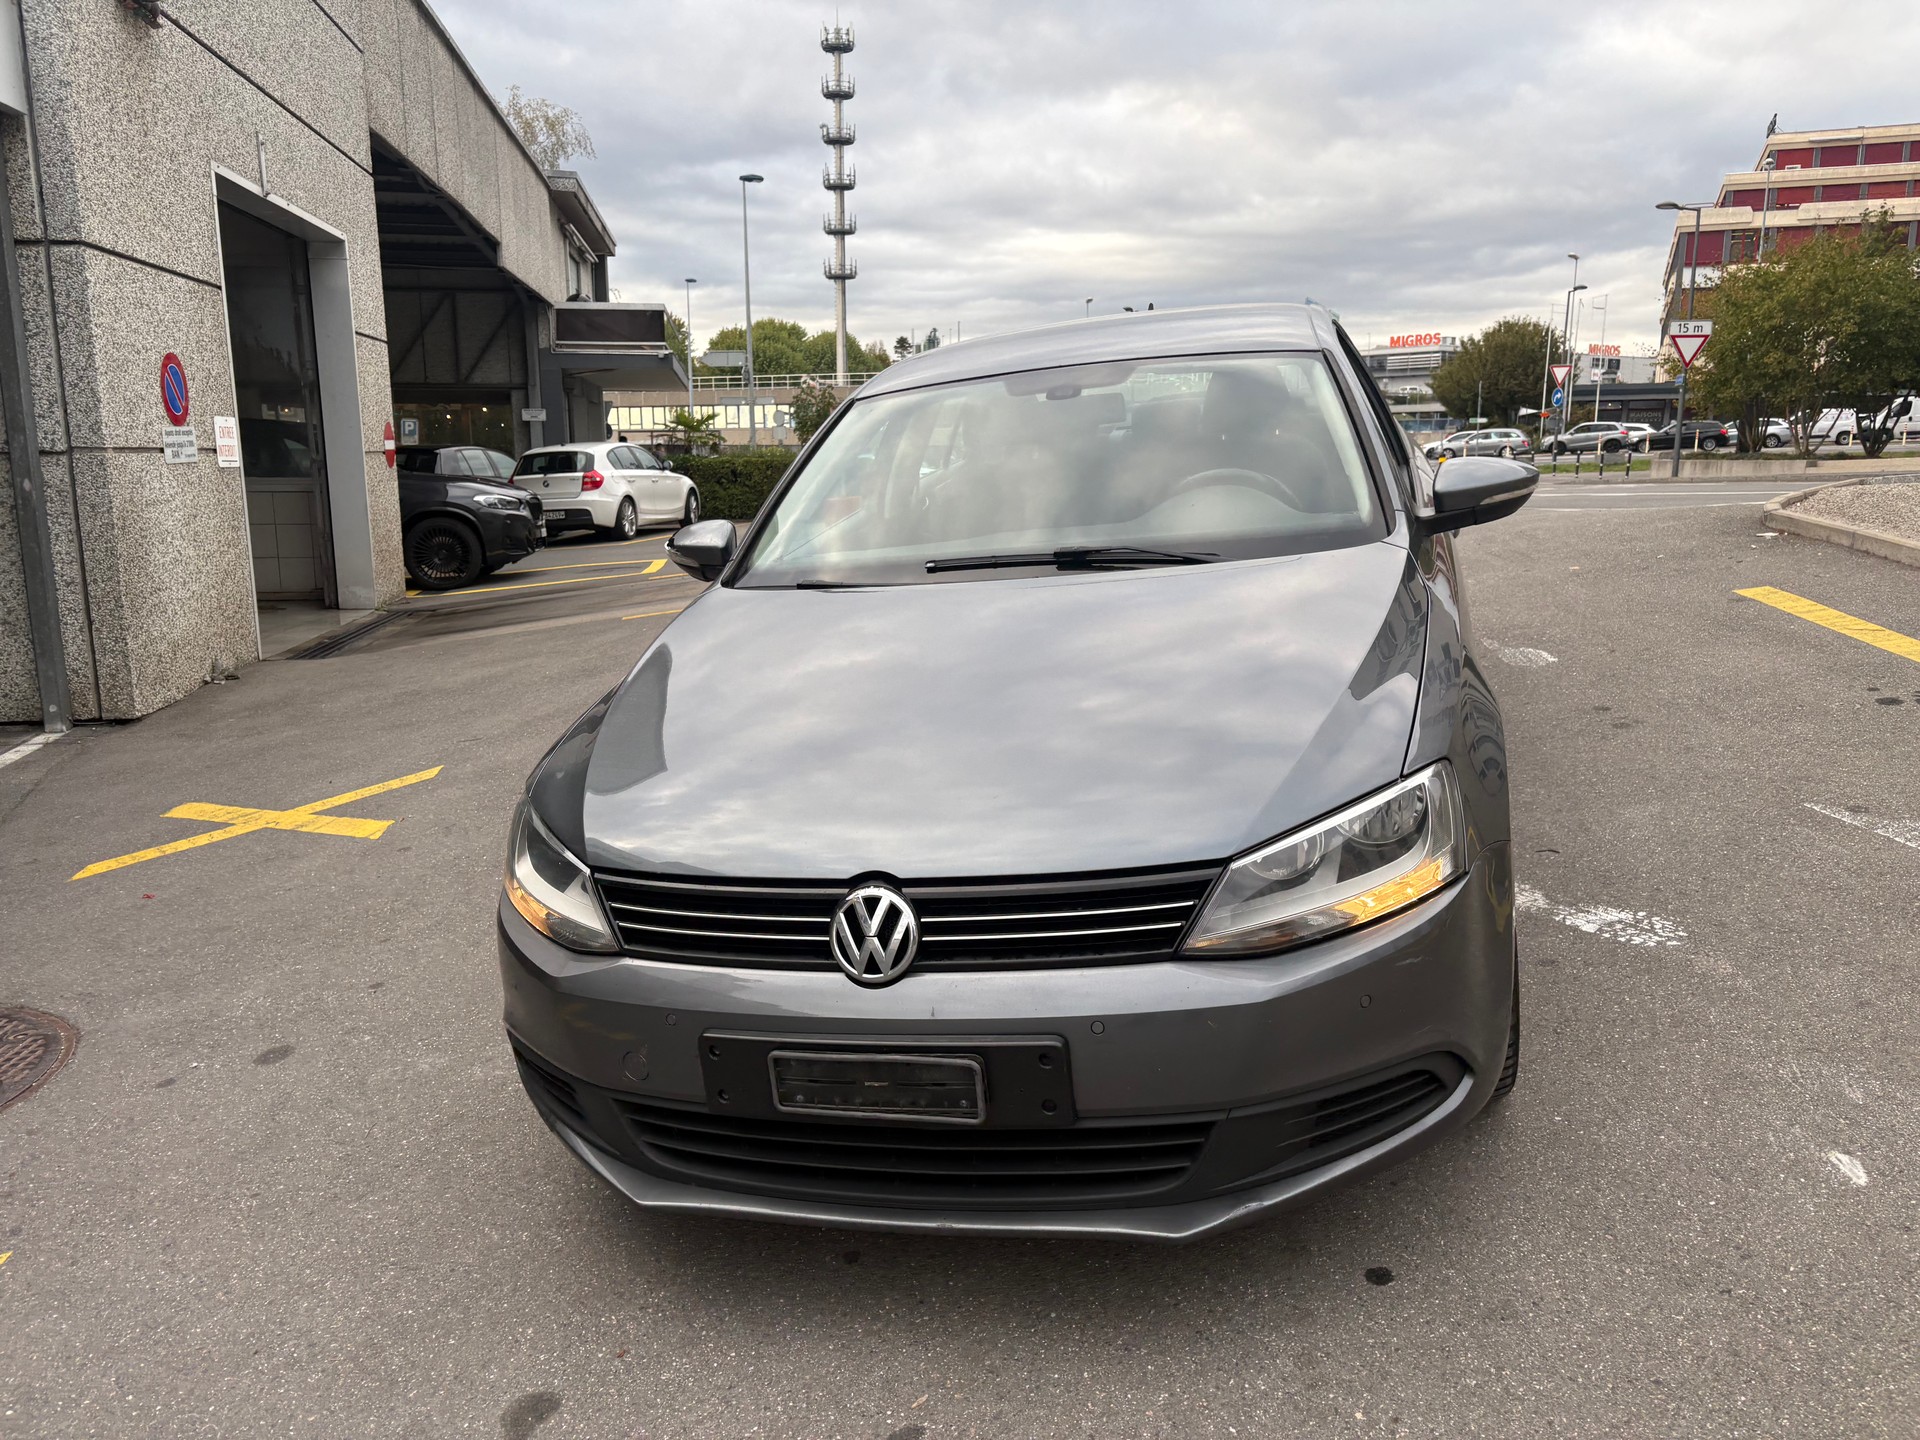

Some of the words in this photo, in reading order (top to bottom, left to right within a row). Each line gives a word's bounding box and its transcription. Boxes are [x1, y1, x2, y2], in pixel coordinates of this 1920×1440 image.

[1678, 323, 1689, 333] 15
[1693, 325, 1703, 333] m
[1389, 332, 1441, 348] MIGROS
[1588, 343, 1621, 356] MIGROS
[405, 421, 414, 434] P
